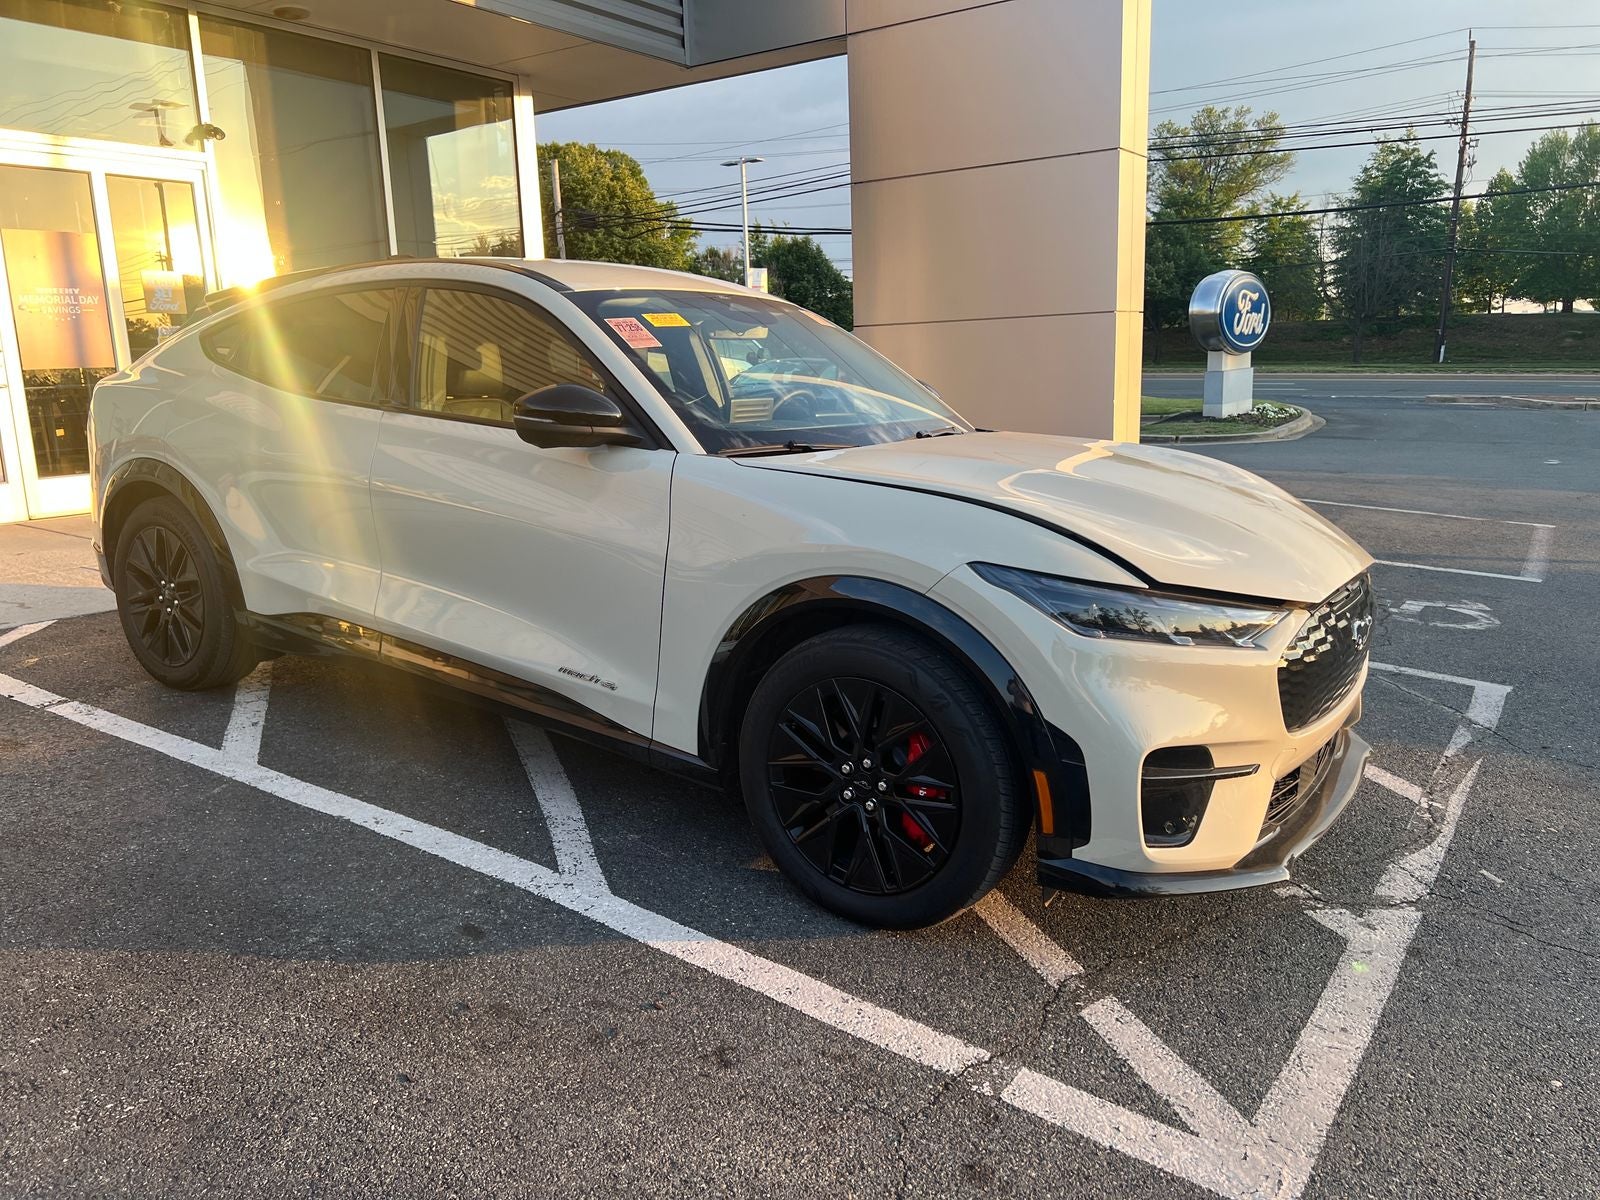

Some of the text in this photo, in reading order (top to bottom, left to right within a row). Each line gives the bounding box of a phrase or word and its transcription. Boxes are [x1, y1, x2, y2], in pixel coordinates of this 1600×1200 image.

[18, 295, 99, 305] MEMORIAL DAY
[149, 297, 179, 311] Ford
[41, 305, 81, 314] SAVINGS
[1233, 289, 1266, 336] Ford
